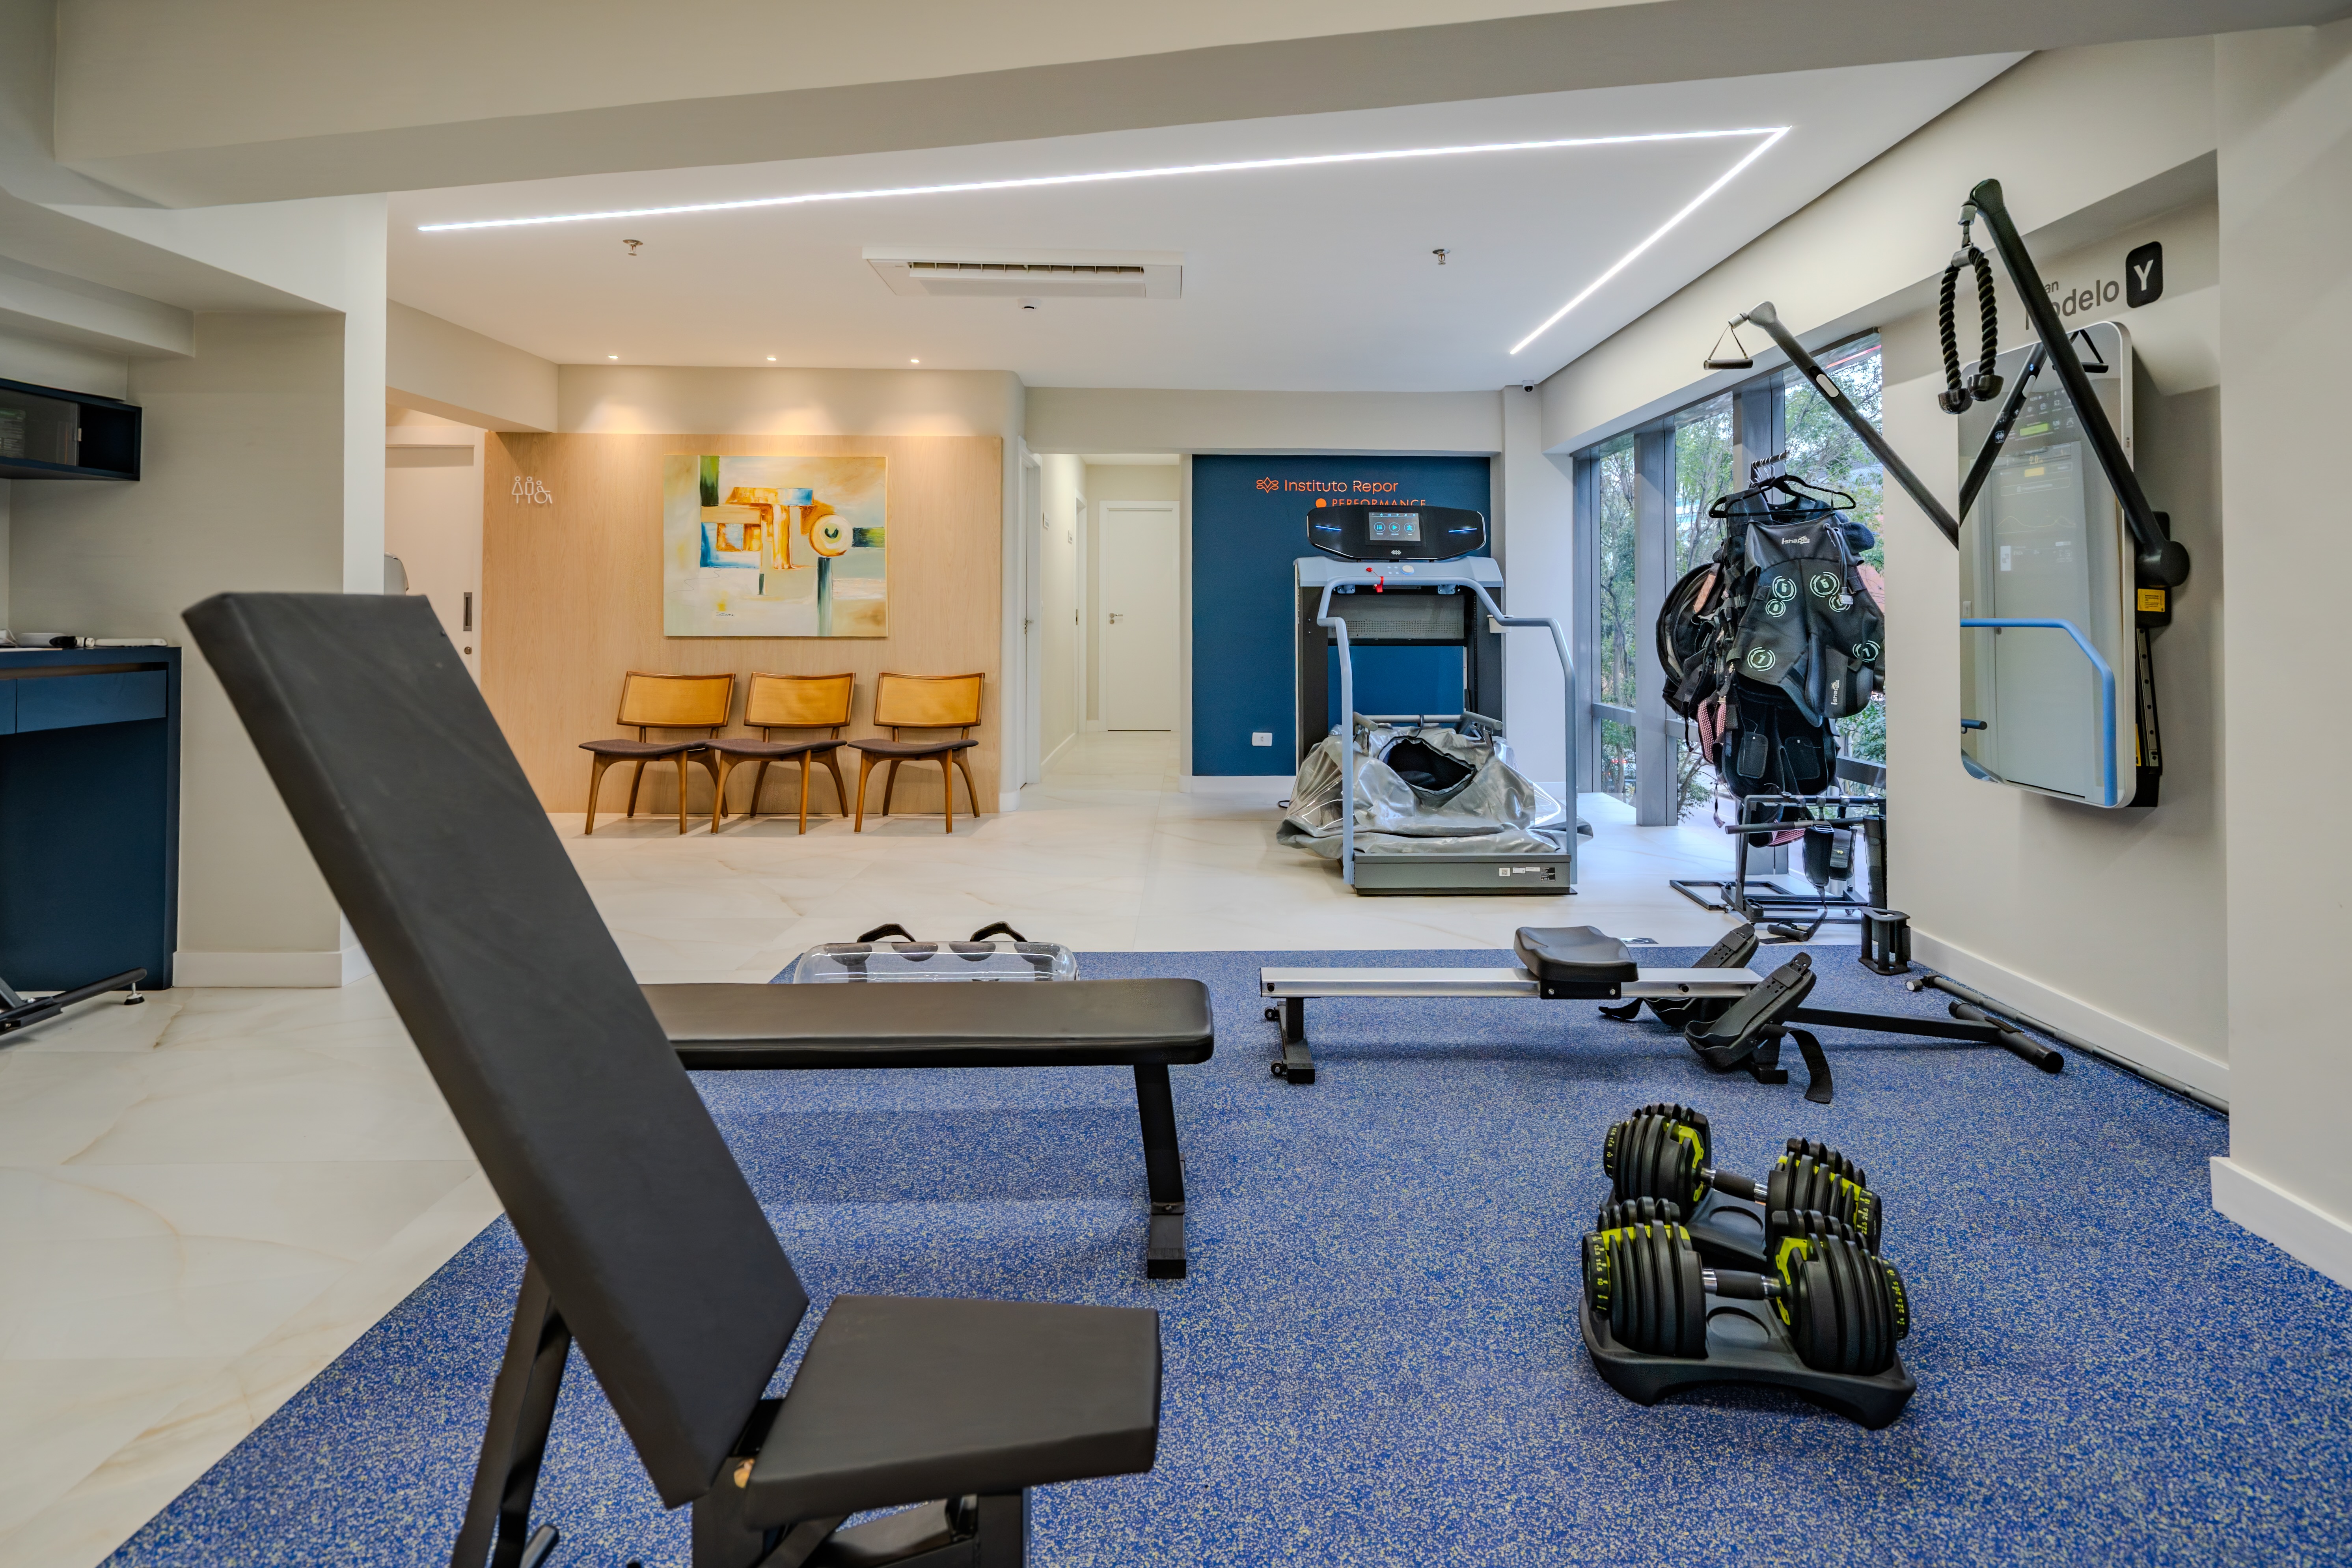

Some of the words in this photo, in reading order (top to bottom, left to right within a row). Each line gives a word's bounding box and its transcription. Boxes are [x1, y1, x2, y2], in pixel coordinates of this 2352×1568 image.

[2026, 280, 2119, 330] delo
[2134, 259, 2154, 291] Y
[1285, 479, 1347, 492] Instituto
[1353, 480, 1399, 495] Repor
[1781, 583, 1787, 593] 5
[1820, 578, 1830, 589] 5
[1757, 654, 1766, 664] 7
